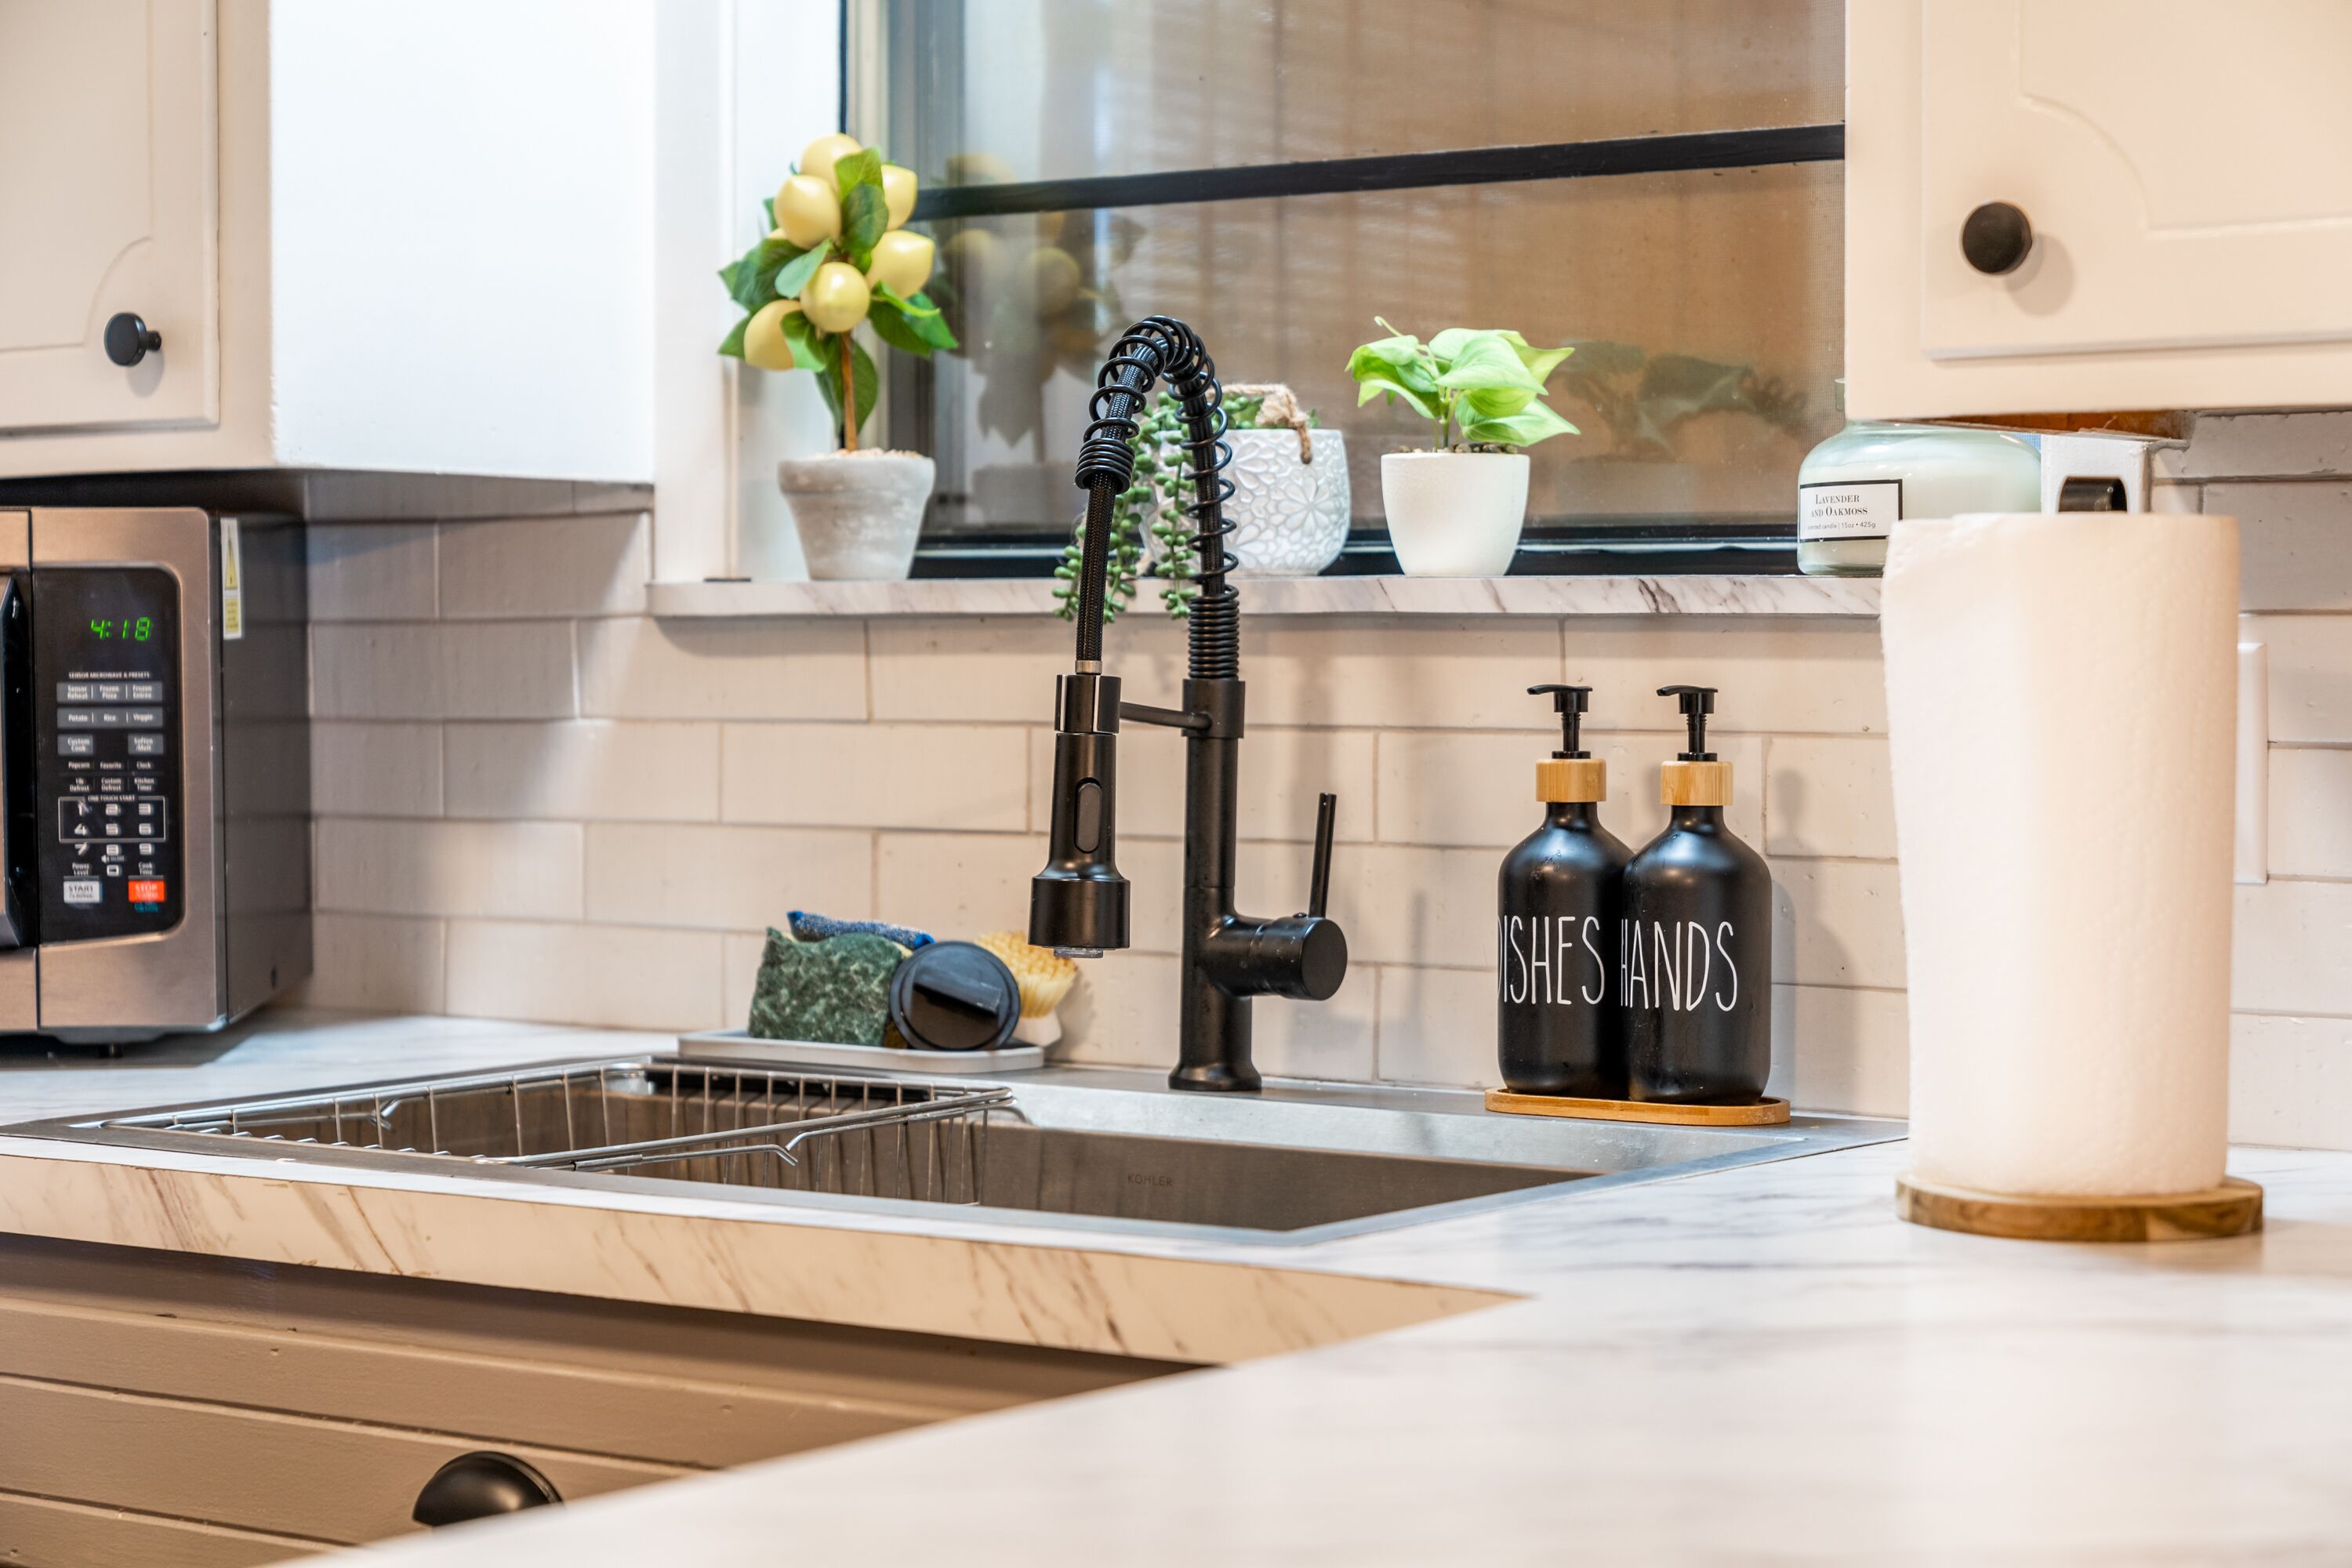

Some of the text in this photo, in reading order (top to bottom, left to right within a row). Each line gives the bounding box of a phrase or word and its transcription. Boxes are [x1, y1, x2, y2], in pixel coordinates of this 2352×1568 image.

[1815, 494, 1860, 504] LAVENDER
[1825, 506, 1868, 517] OAKMOSS
[90, 617, 151, 641] 4:18
[68, 713, 88, 722] Potato
[132, 713, 153, 722] Veggie
[68, 761, 90, 770] Popcorn
[100, 760, 122, 769] Favorite
[74, 823, 88, 837] 4
[74, 843, 88, 856] 7
[136, 884, 158, 892] STOP
[1621, 919, 1738, 1011] HANDS
[1127, 1173, 1173, 1186] KOHLER
